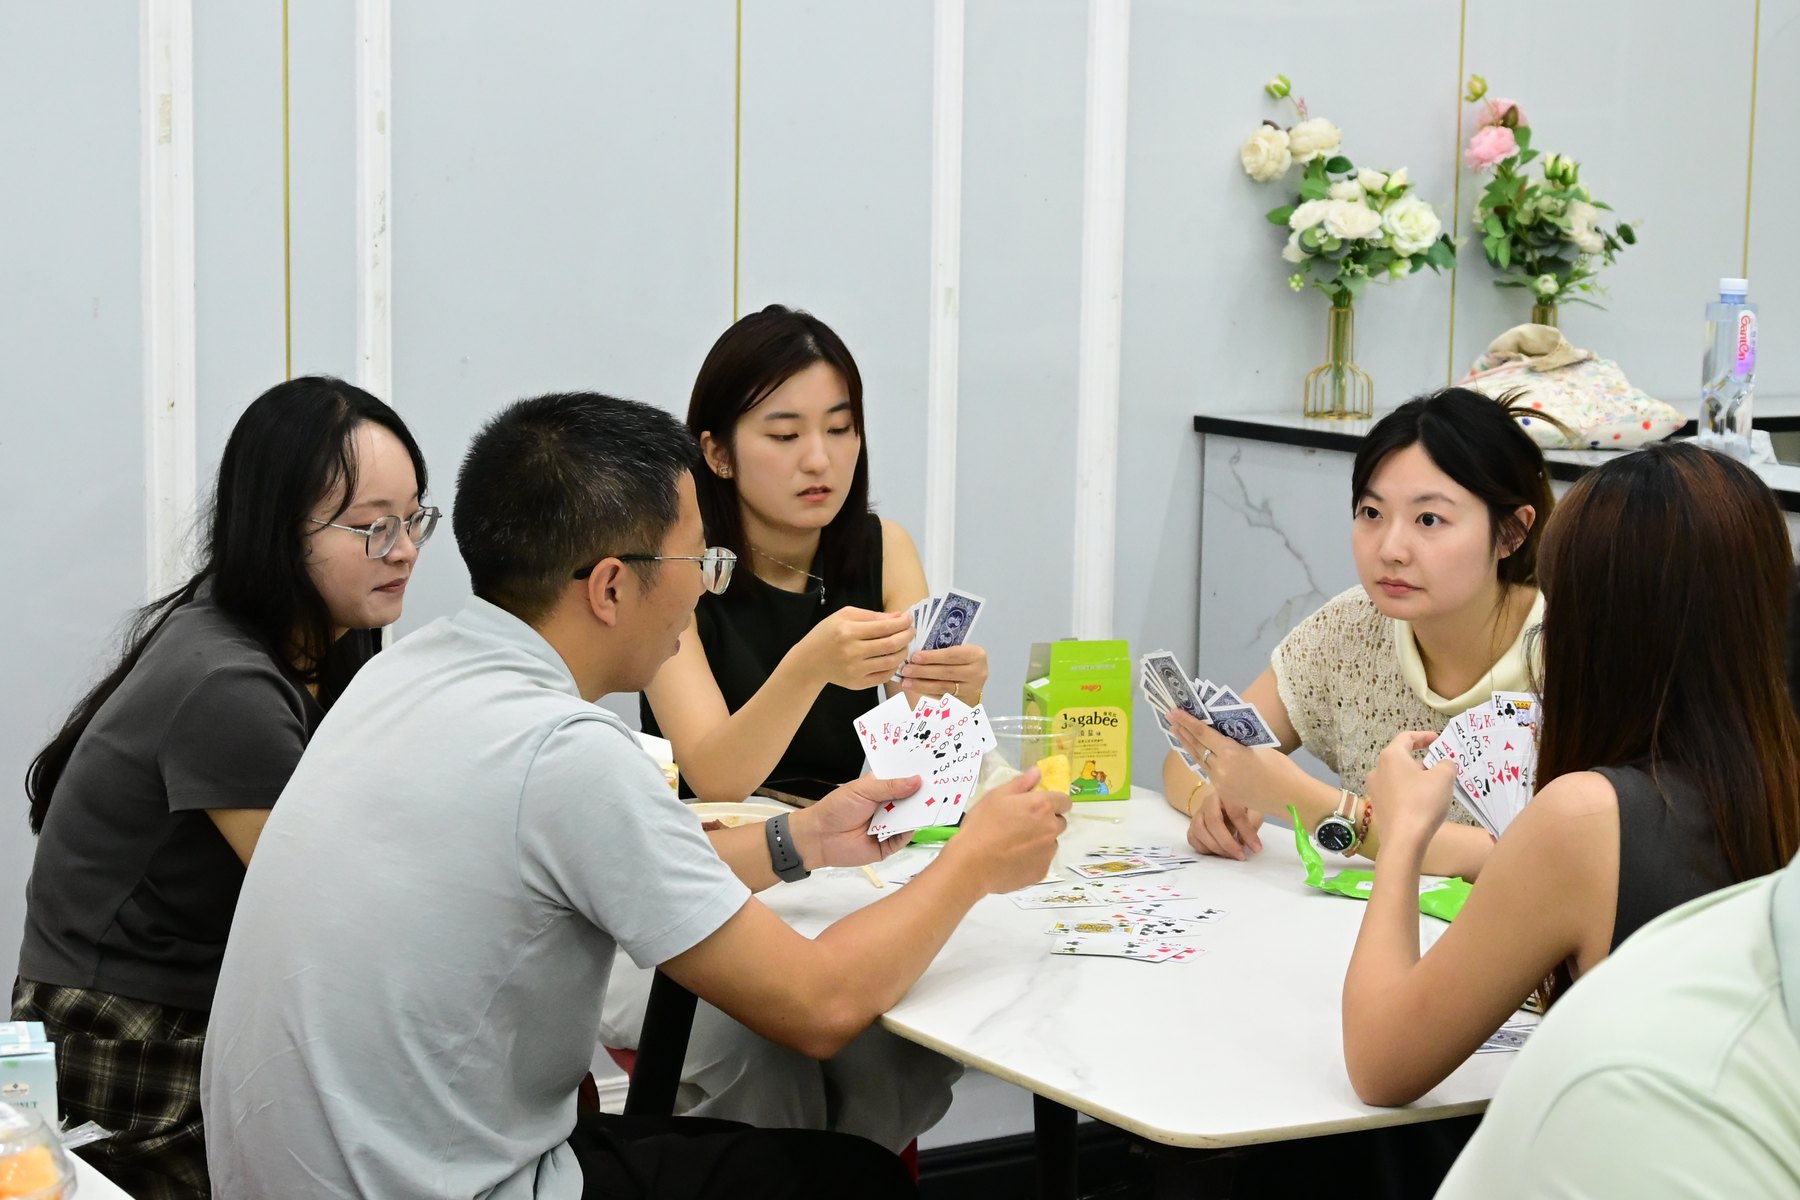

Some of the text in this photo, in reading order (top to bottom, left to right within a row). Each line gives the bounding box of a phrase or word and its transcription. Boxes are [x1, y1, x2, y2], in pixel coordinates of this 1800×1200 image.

[1495, 695, 1503, 708] K
[858, 721, 865, 731] A
[1469, 714, 1476, 727] K
[1484, 715, 1491, 727] K
[883, 723, 890, 734] K
[1455, 721, 1464, 734] A
[870, 733, 877, 744] A
[1441, 740, 1451, 753] A
